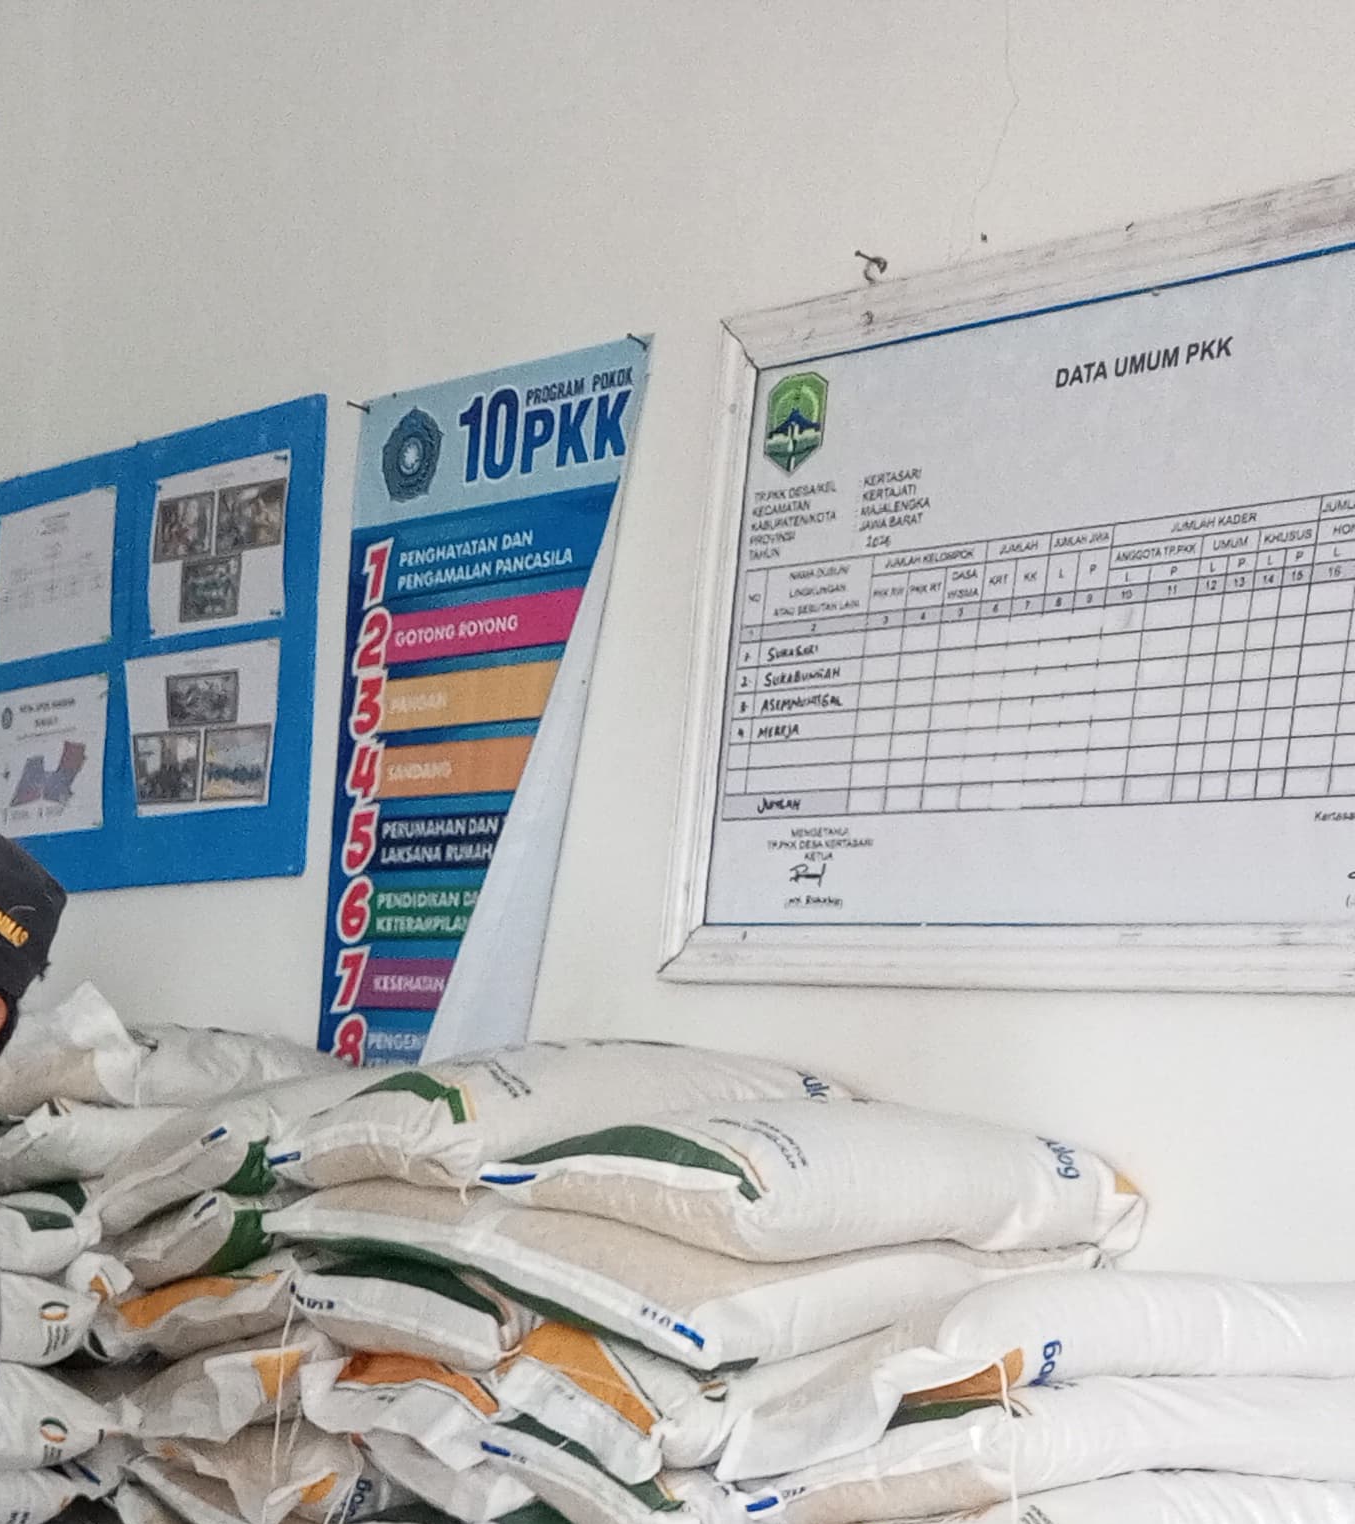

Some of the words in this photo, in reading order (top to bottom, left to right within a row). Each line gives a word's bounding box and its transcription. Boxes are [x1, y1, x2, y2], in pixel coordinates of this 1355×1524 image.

[1055, 361, 1108, 388] DATA
[1115, 346, 1180, 377] UMUM
[1185, 336, 1234, 365] PKK
[525, 377, 585, 406] PROGRAM
[591, 367, 634, 393] POKOK
[459, 387, 520, 484] 10
[520, 390, 633, 475] PKK
[863, 469, 923, 487] KERTASARI
[751, 500, 812, 518] KECAMATAN
[860, 497, 931, 517] MAJALENGKA
[888, 512, 924, 528] BARAT
[1171, 519, 1215, 533] JUMLAH
[1217, 512, 1258, 529] KADER
[1212, 536, 1250, 551] UMUM
[1263, 528, 1313, 544] KHUSUS
[399, 536, 498, 568] PENGHAYATAN
[502, 530, 534, 552] DAN
[1115, 549, 1162, 562] ANGGOTA
[362, 538, 395, 611] 1
[397, 560, 492, 591] PENGAMALAN
[496, 548, 573, 575] PANCASILA
[1263, 574, 1275, 585] 14
[1205, 579, 1217, 591] 12
[1233, 577, 1245, 588] 13
[355, 607, 392, 676] 2
[395, 621, 455, 647] GOTONG
[459, 615, 519, 638] ROYONG
[350, 674, 386, 741] 3
[347, 742, 385, 801] 4
[382, 818, 467, 839] PERUMAHAN
[468, 817, 500, 835] DAN
[341, 803, 381, 877] 5
[380, 845, 443, 864] LAKSANA
[337, 875, 374, 945] 6
[377, 891, 460, 910] PENDIDIKAN
[330, 945, 372, 1014] 7
